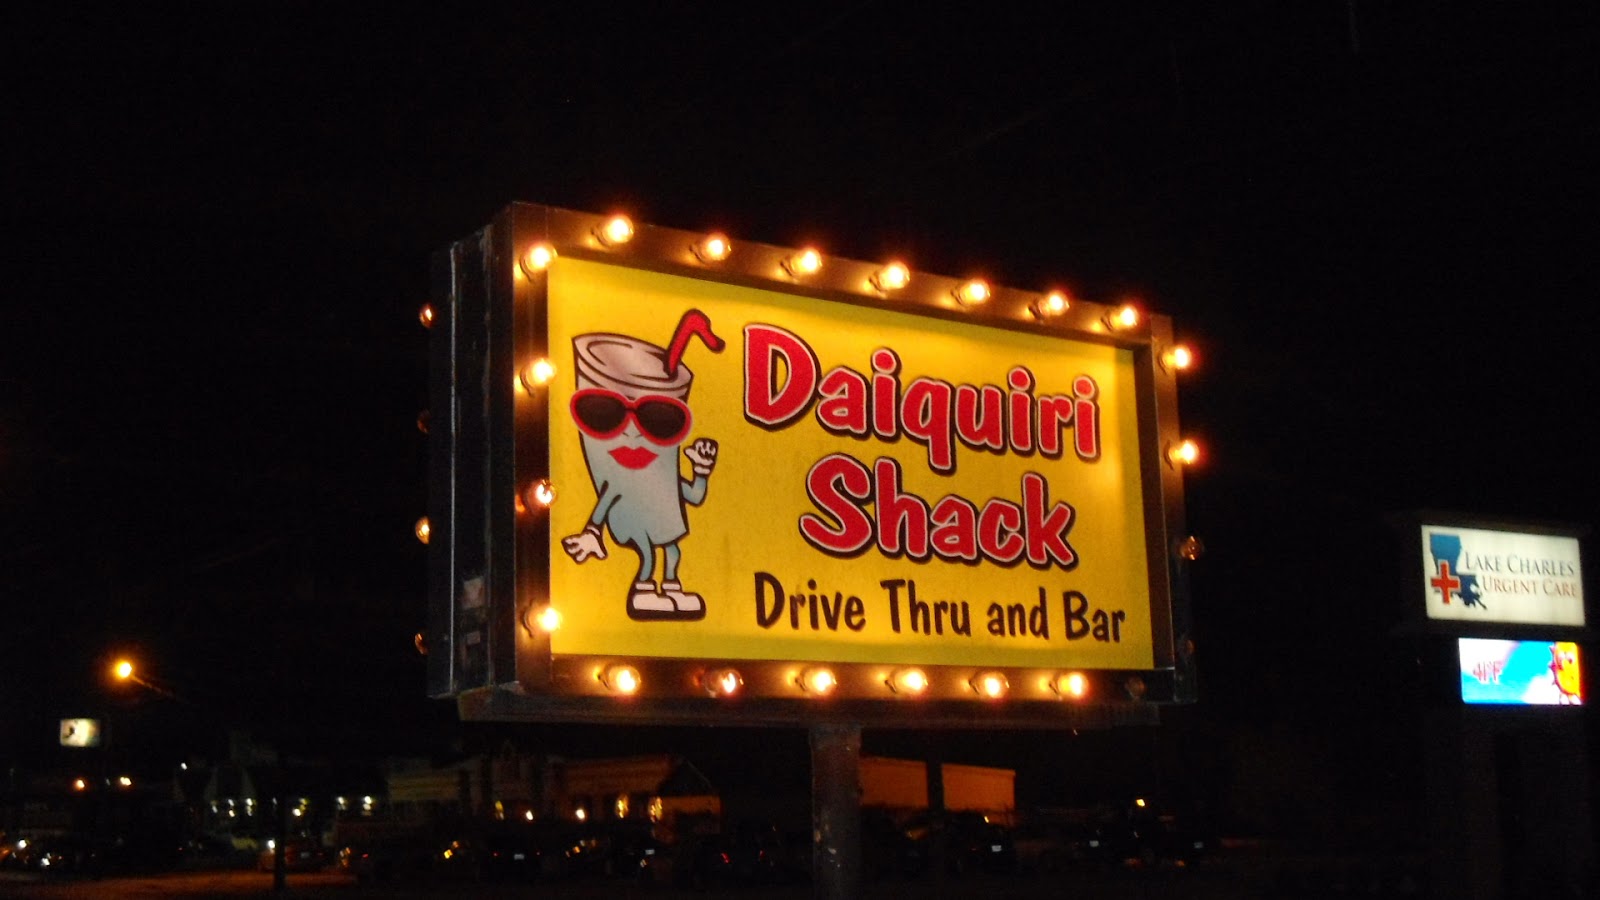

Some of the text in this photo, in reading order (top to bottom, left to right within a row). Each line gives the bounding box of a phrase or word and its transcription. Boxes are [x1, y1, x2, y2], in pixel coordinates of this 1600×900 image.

[743, 322, 1101, 474] Daiquiri
[799, 453, 1077, 571] Shack
[1465, 551, 1575, 576] LAKE CHARLES
[1482, 576, 1577, 597] URGENT CARE
[755, 572, 1126, 643] Drive Thru and Bar
